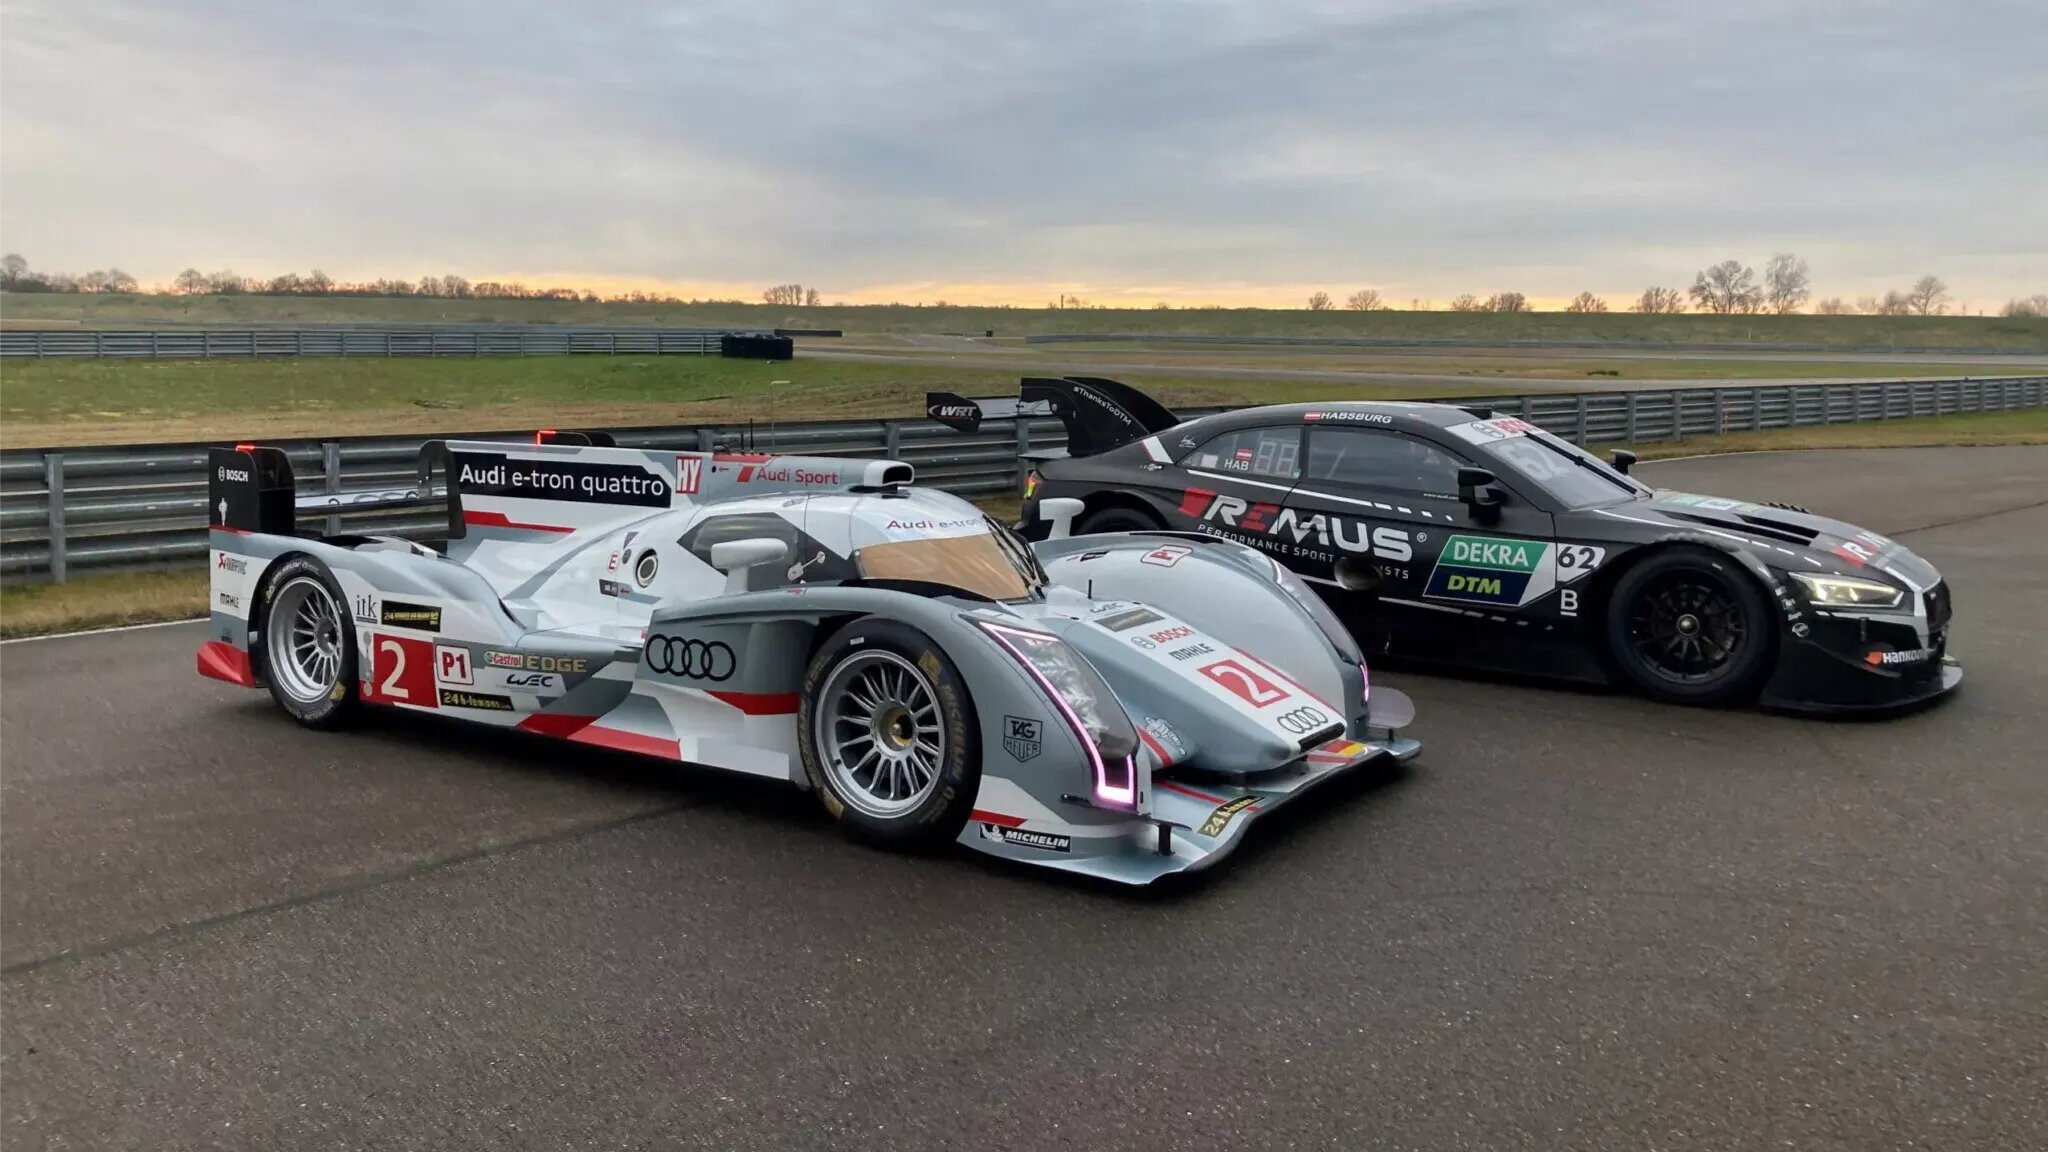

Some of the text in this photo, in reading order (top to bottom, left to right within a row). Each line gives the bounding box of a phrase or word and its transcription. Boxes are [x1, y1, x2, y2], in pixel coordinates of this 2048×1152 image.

[940, 406, 977, 417] WRT
[1073, 386, 1132, 426] #ThanksToDTM
[1320, 412, 1393, 424] HABSBURG
[1224, 459, 1249, 471] HAB
[226, 469, 249, 482] BOSCH
[460, 464, 665, 497] Audi e-tron quattro
[676, 459, 702, 492] HY
[756, 468, 839, 486] Audi Sport
[887, 520, 934, 529] Audi
[1203, 496, 1413, 562] REMUS
[1197, 524, 1334, 563] PERFORMANCE SPORT
[1453, 541, 1529, 567] DEKRA
[1557, 546, 1597, 570] 62
[1447, 575, 1501, 595] DTM
[356, 594, 377, 618] itk
[1148, 625, 1196, 644] BOSCH
[380, 640, 409, 699] 2
[441, 651, 467, 679] P1
[493, 653, 588, 673] Castrol EDGE
[506, 673, 554, 688] WEC
[1210, 664, 1281, 701] 2
[1010, 720, 1036, 739] TAG
[1006, 741, 1039, 759] HEUER
[1005, 830, 1070, 848] MICHELIN
